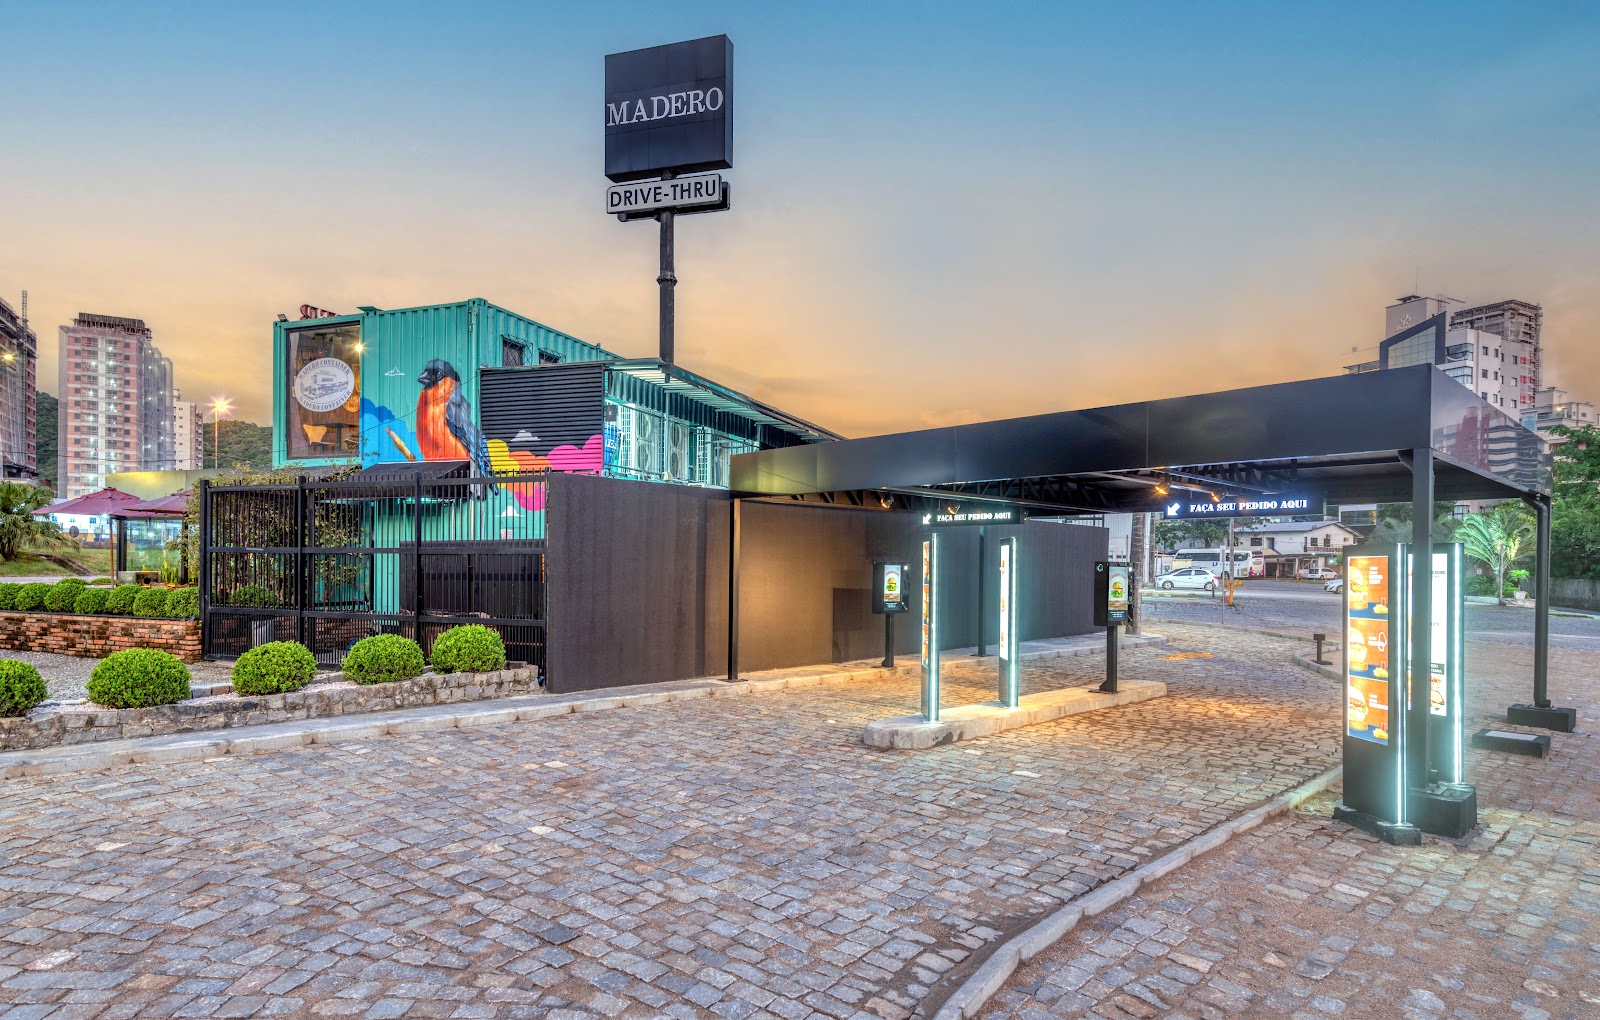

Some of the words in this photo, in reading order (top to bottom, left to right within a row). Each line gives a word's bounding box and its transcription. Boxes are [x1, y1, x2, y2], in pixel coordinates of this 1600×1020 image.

[607, 87, 724, 126] MADERO
[610, 180, 716, 207] DRIVE-THRU
[320, 359, 351, 376] CONTAINER
[321, 390, 351, 410] CONTAINER
[1190, 503, 1214, 514] FAÇA
[1217, 502, 1236, 512] SEU
[1239, 501, 1277, 510] PEDIDO
[1280, 499, 1308, 509] AQUI
[937, 514, 953, 522] FAÇA
[954, 513, 967, 521] SEU
[968, 512, 993, 520] PEDIDO
[993, 511, 1011, 520] AQUI
